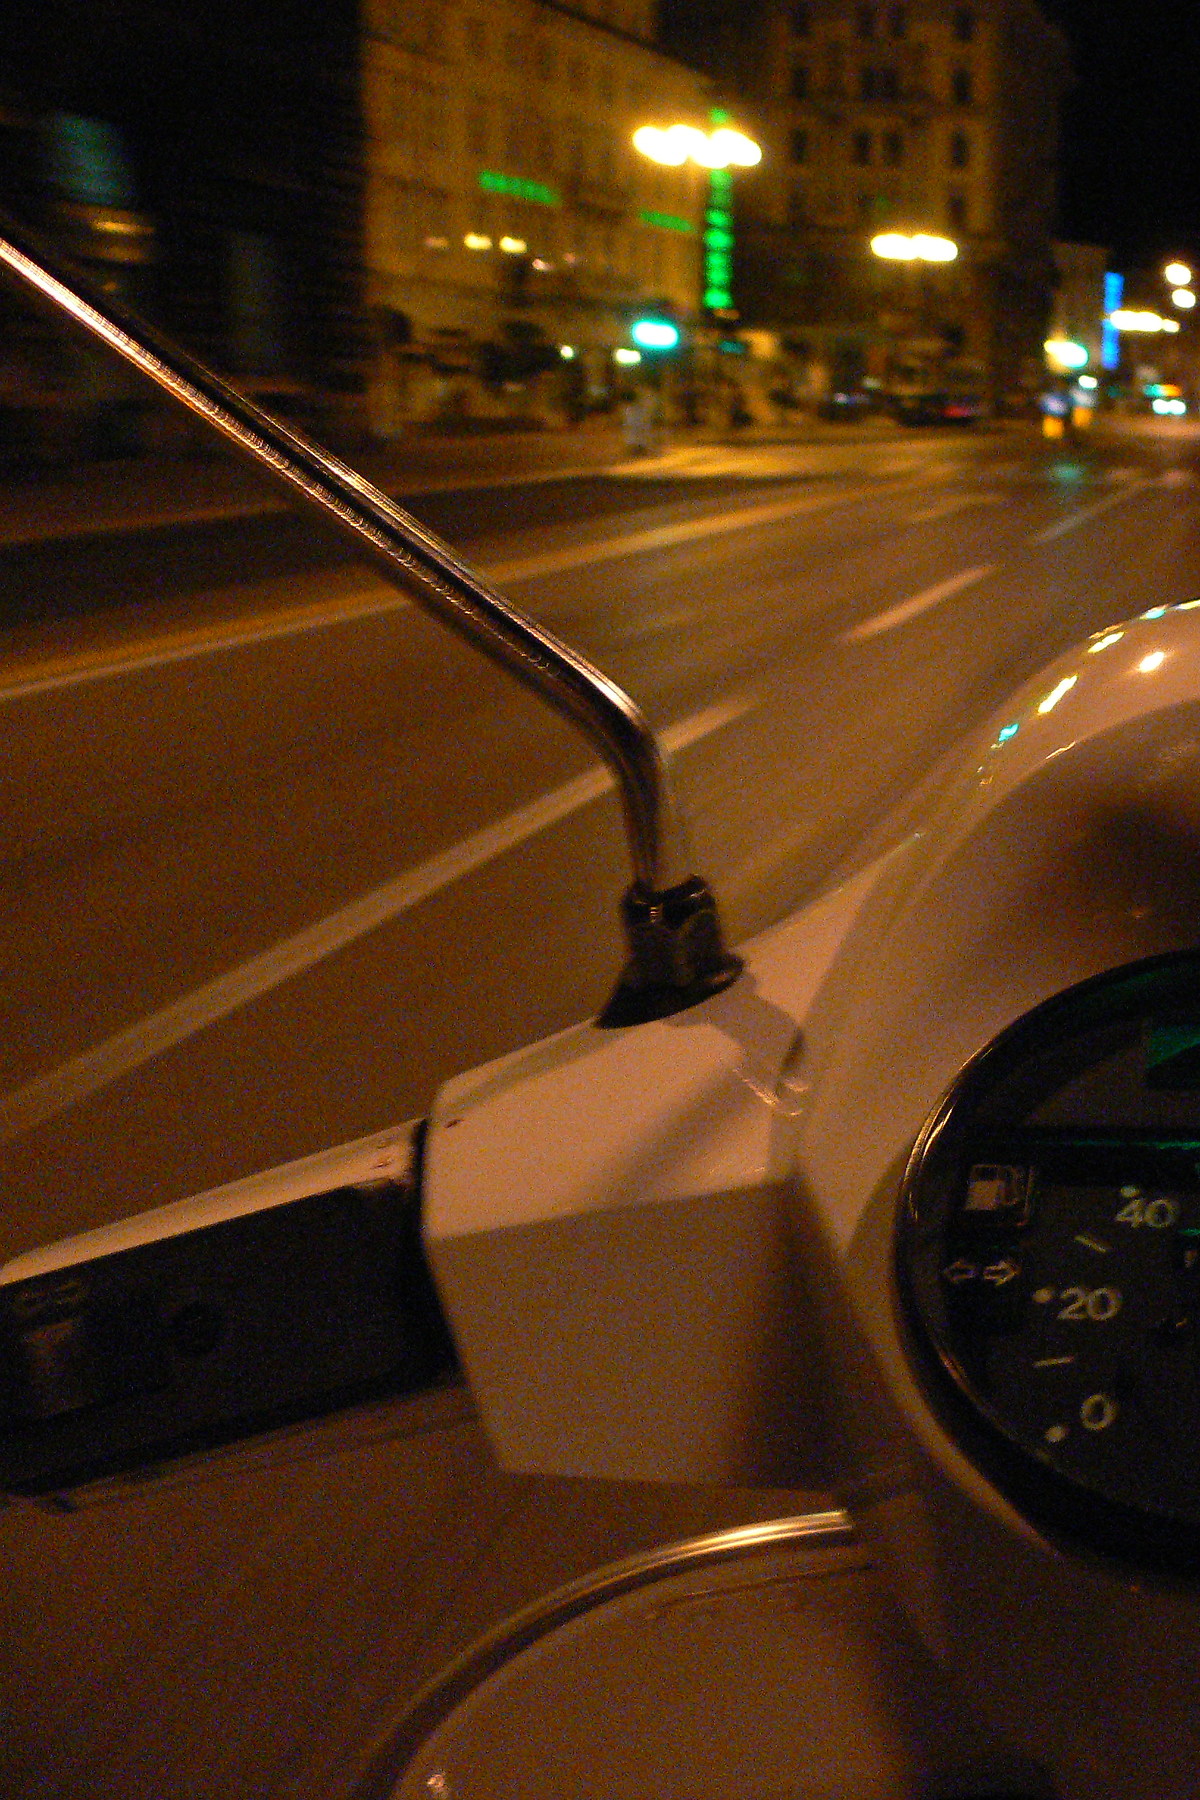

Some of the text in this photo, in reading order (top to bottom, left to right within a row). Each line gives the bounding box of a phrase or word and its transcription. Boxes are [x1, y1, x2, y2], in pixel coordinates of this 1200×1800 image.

[1115, 1198, 1177, 1229] 40
[1057, 1286, 1122, 1322] 20
[1080, 1393, 1118, 1431] 0
